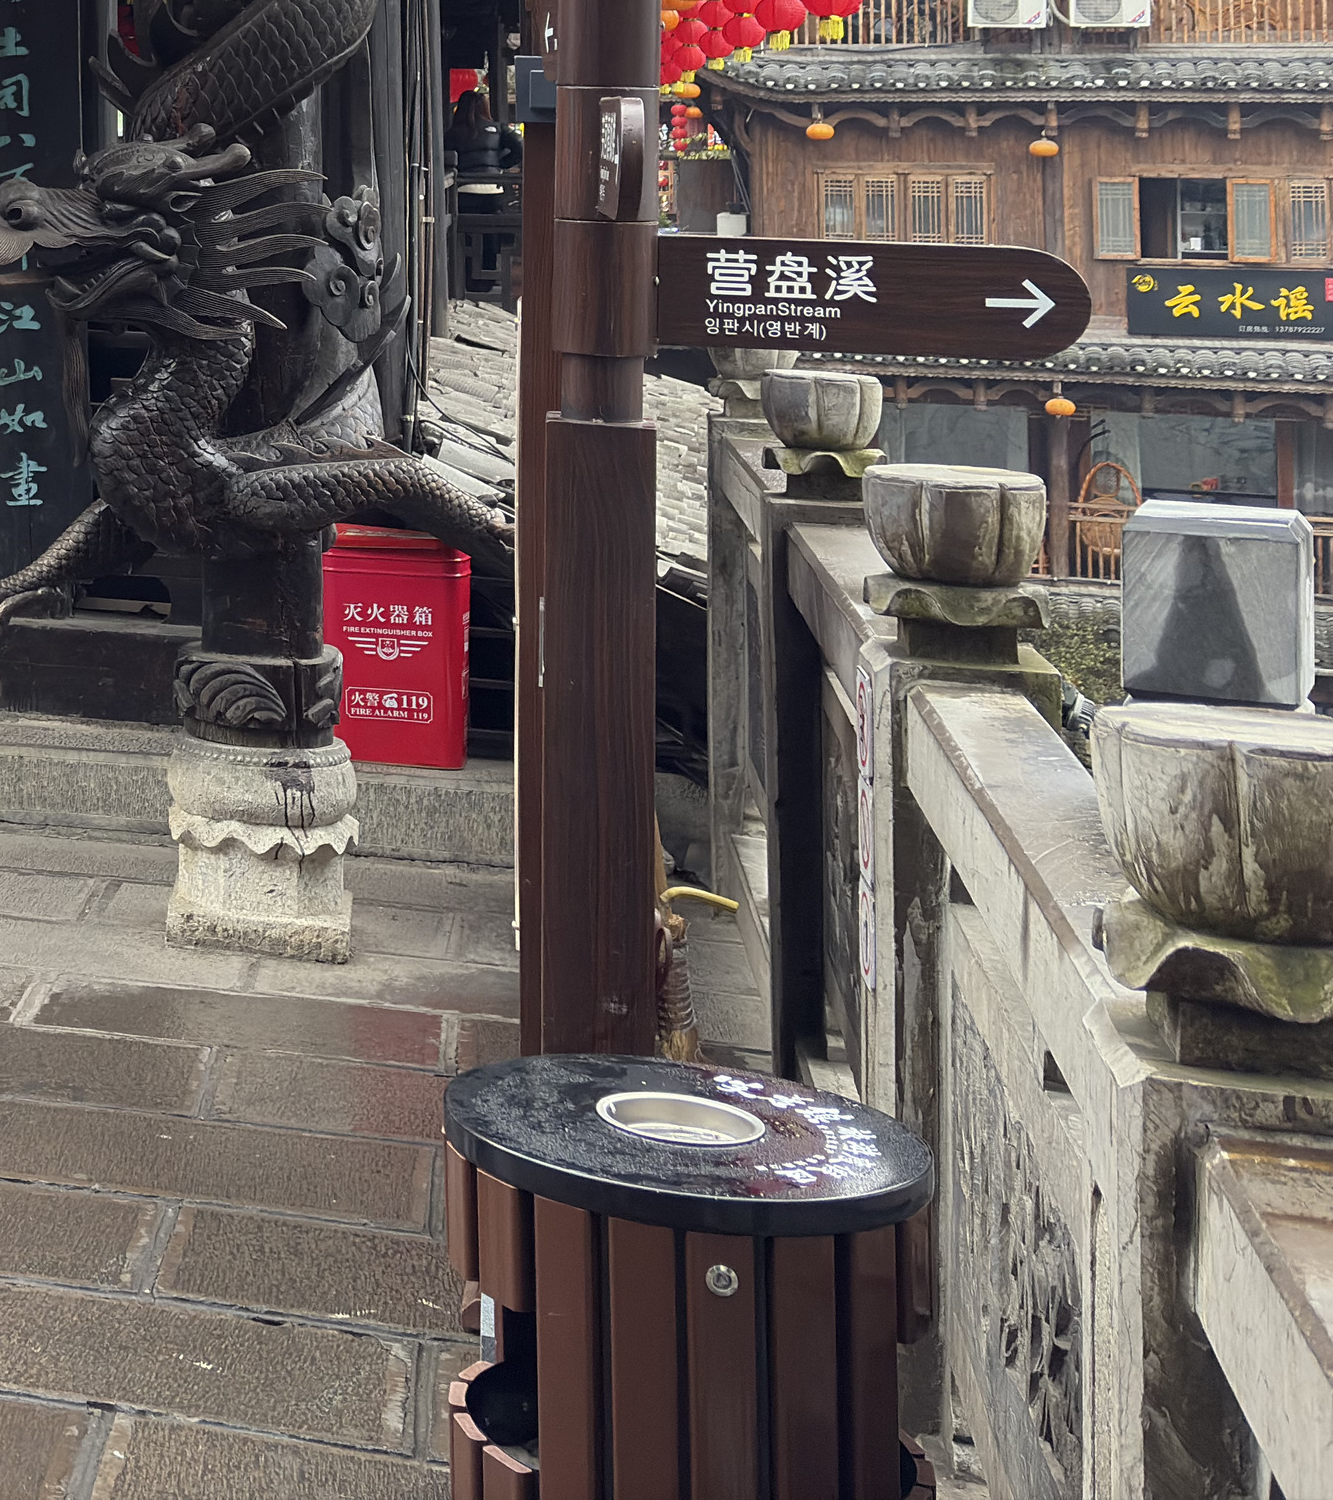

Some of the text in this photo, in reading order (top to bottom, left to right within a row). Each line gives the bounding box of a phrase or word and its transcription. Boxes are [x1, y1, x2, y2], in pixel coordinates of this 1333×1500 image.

[706, 249, 878, 303] 营盘溪
[705, 299, 841, 319] YingpanStream
[1164, 282, 1315, 321] 云水谣
[704, 318, 827, 341] 잉판시(영반계)
[343, 603, 433, 626] 灭火器箱
[342, 625, 433, 638] FIRE EXTINGUISHER BOX
[351, 691, 428, 710] 火警 119
[351, 707, 429, 720] FIRE ALARM 119
